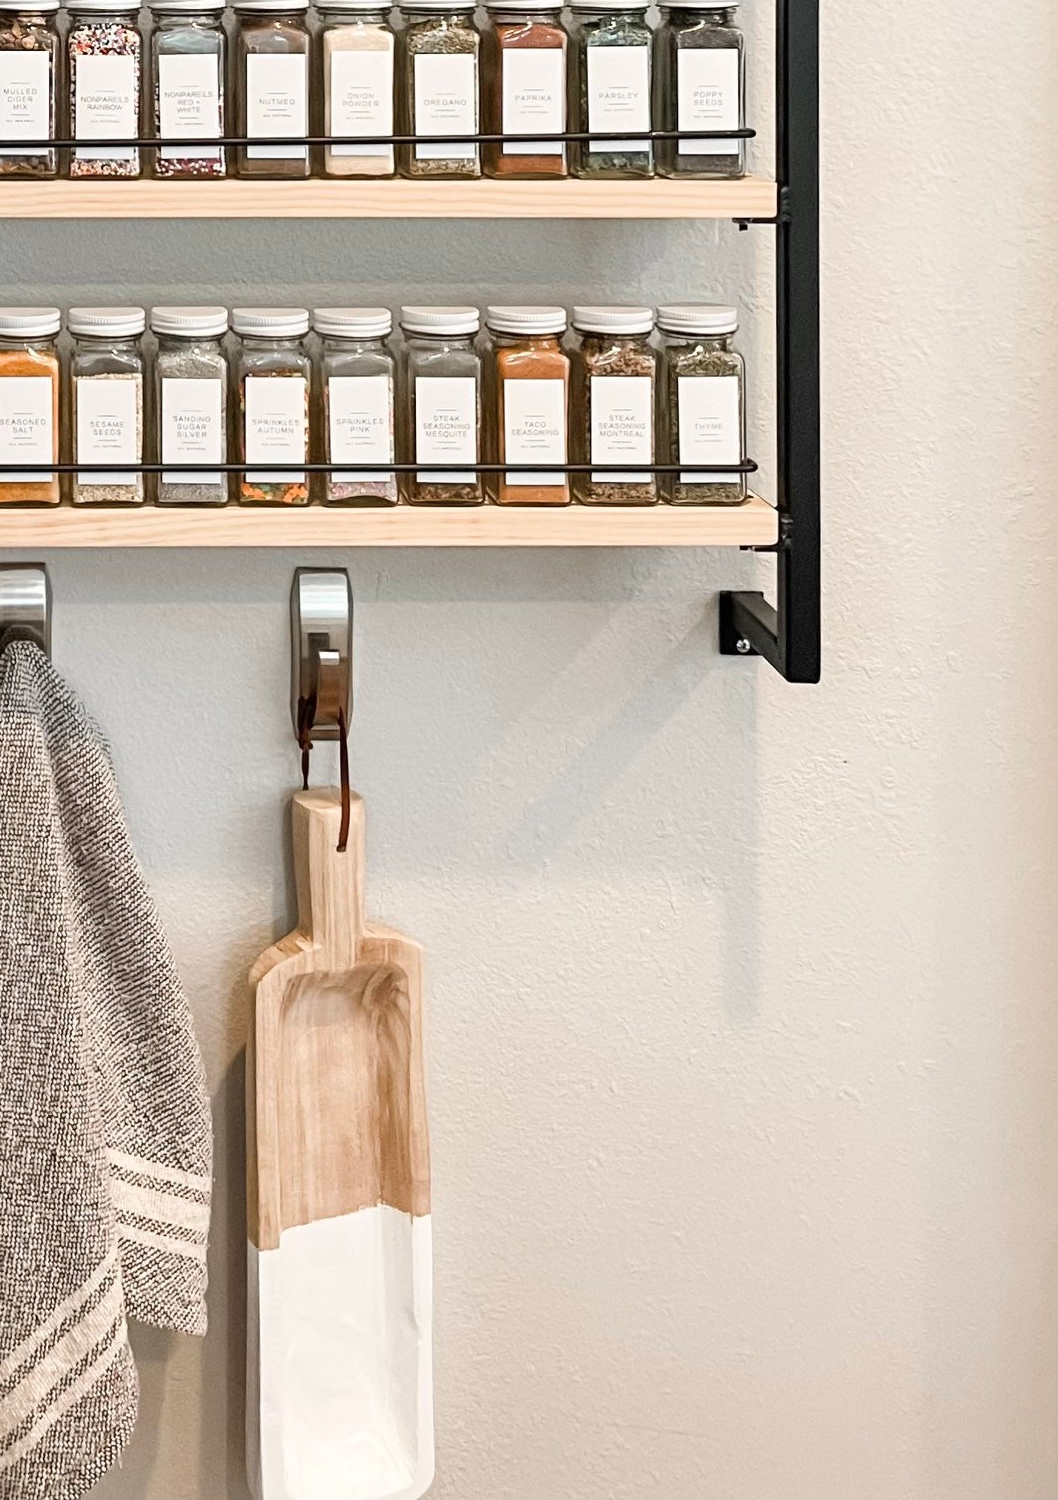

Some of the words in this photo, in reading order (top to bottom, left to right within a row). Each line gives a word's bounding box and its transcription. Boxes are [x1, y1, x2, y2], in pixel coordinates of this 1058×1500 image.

[3, 87, 38, 96] MULLED
[693, 90, 723, 99] POPPY
[7, 95, 33, 103] CIDER
[347, 92, 375, 100] ONION
[514, 94, 552, 102] PAPRIKA
[599, 92, 639, 100] PARSLEY
[177, 98, 194, 107] RED
[258, 98, 296, 106] NUTMEG
[342, 100, 380, 108] POWDER
[424, 98, 467, 107] OREGANO
[693, 98, 723, 107] SEEDS
[13, 103, 28, 111] MIX
[87, 103, 122, 111] RAINBOW
[177, 106, 201, 114] WHITE
[0, 418, 46, 426] SEASONED
[251, 418, 300, 426] SPRINKLES
[336, 417, 384, 426] SPRINKLES
[433, 414, 460, 423] STEAK
[608, 414, 636, 422] STEAK
[89, 420, 124, 429] SESAME
[177, 423, 208, 431] SUGAR
[422, 422, 471, 430] SEASONING
[598, 422, 646, 430] SEASONING
[694, 422, 723, 431] THYME
[12, 425, 33, 434] SALT
[93, 428, 121, 436] SEEDS
[257, 426, 294, 434] AUTUMN
[349, 425, 370, 433] PINK
[511, 428, 560, 437] SEASONING
[177, 431, 207, 439] SILVER
[599, 430, 645, 438] MONTREAL
